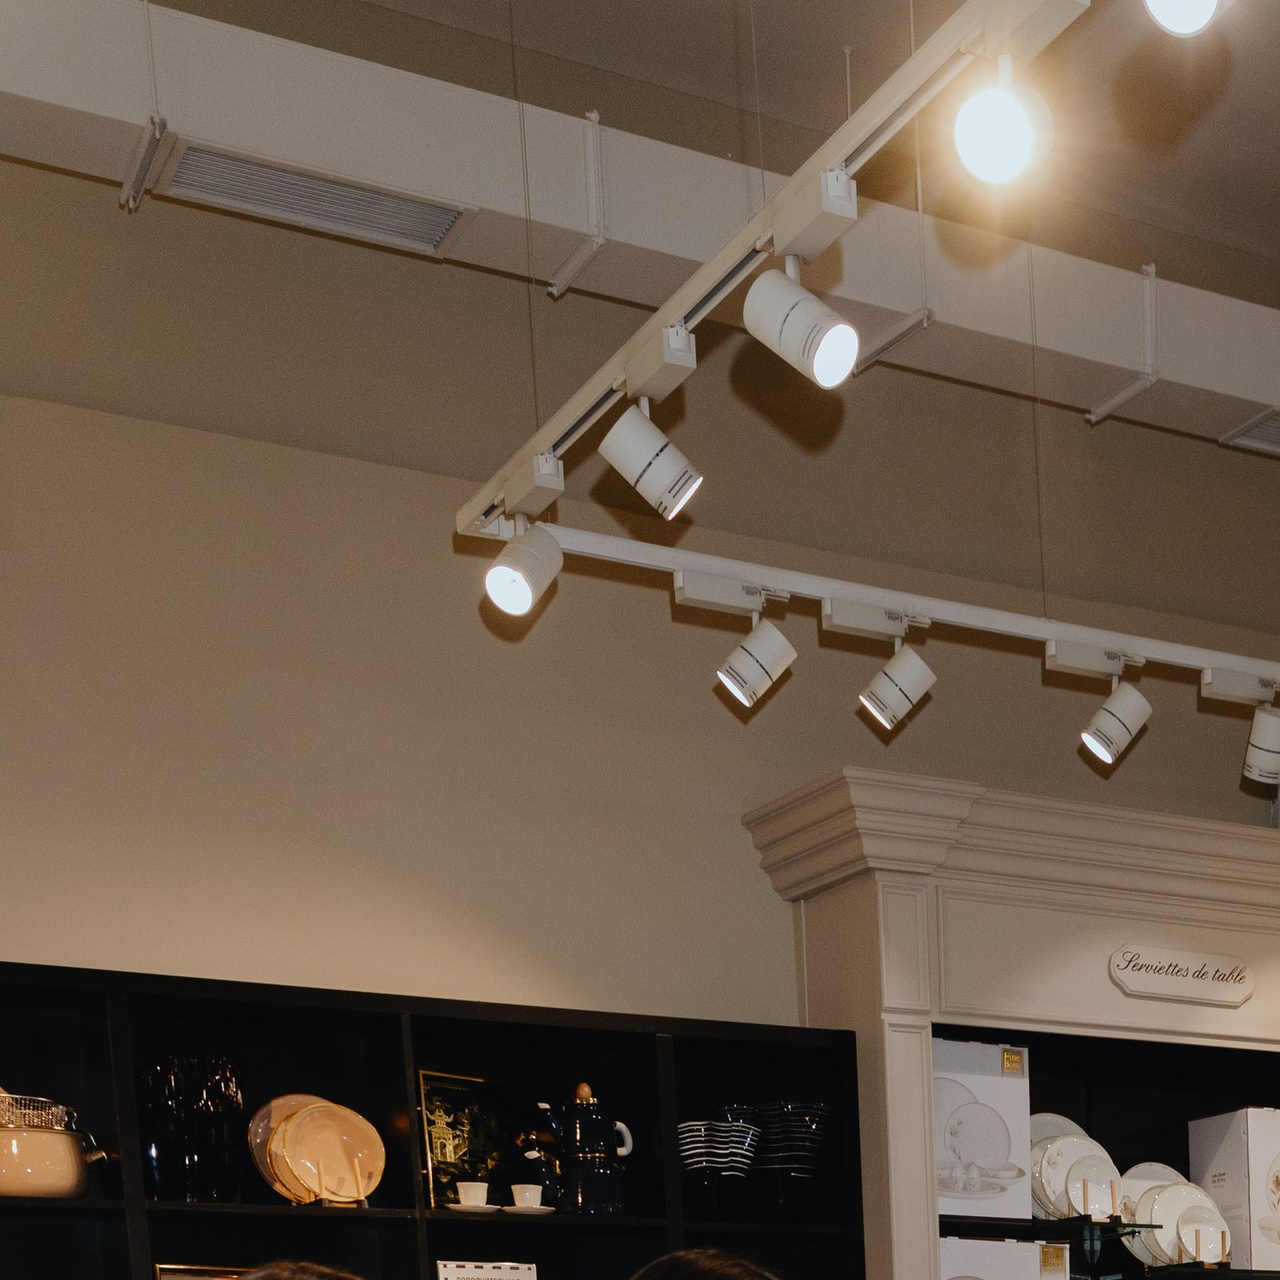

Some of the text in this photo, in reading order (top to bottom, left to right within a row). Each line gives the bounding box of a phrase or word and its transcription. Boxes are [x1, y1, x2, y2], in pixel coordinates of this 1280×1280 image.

[1116, 951, 1247, 985] Serviettes de table
